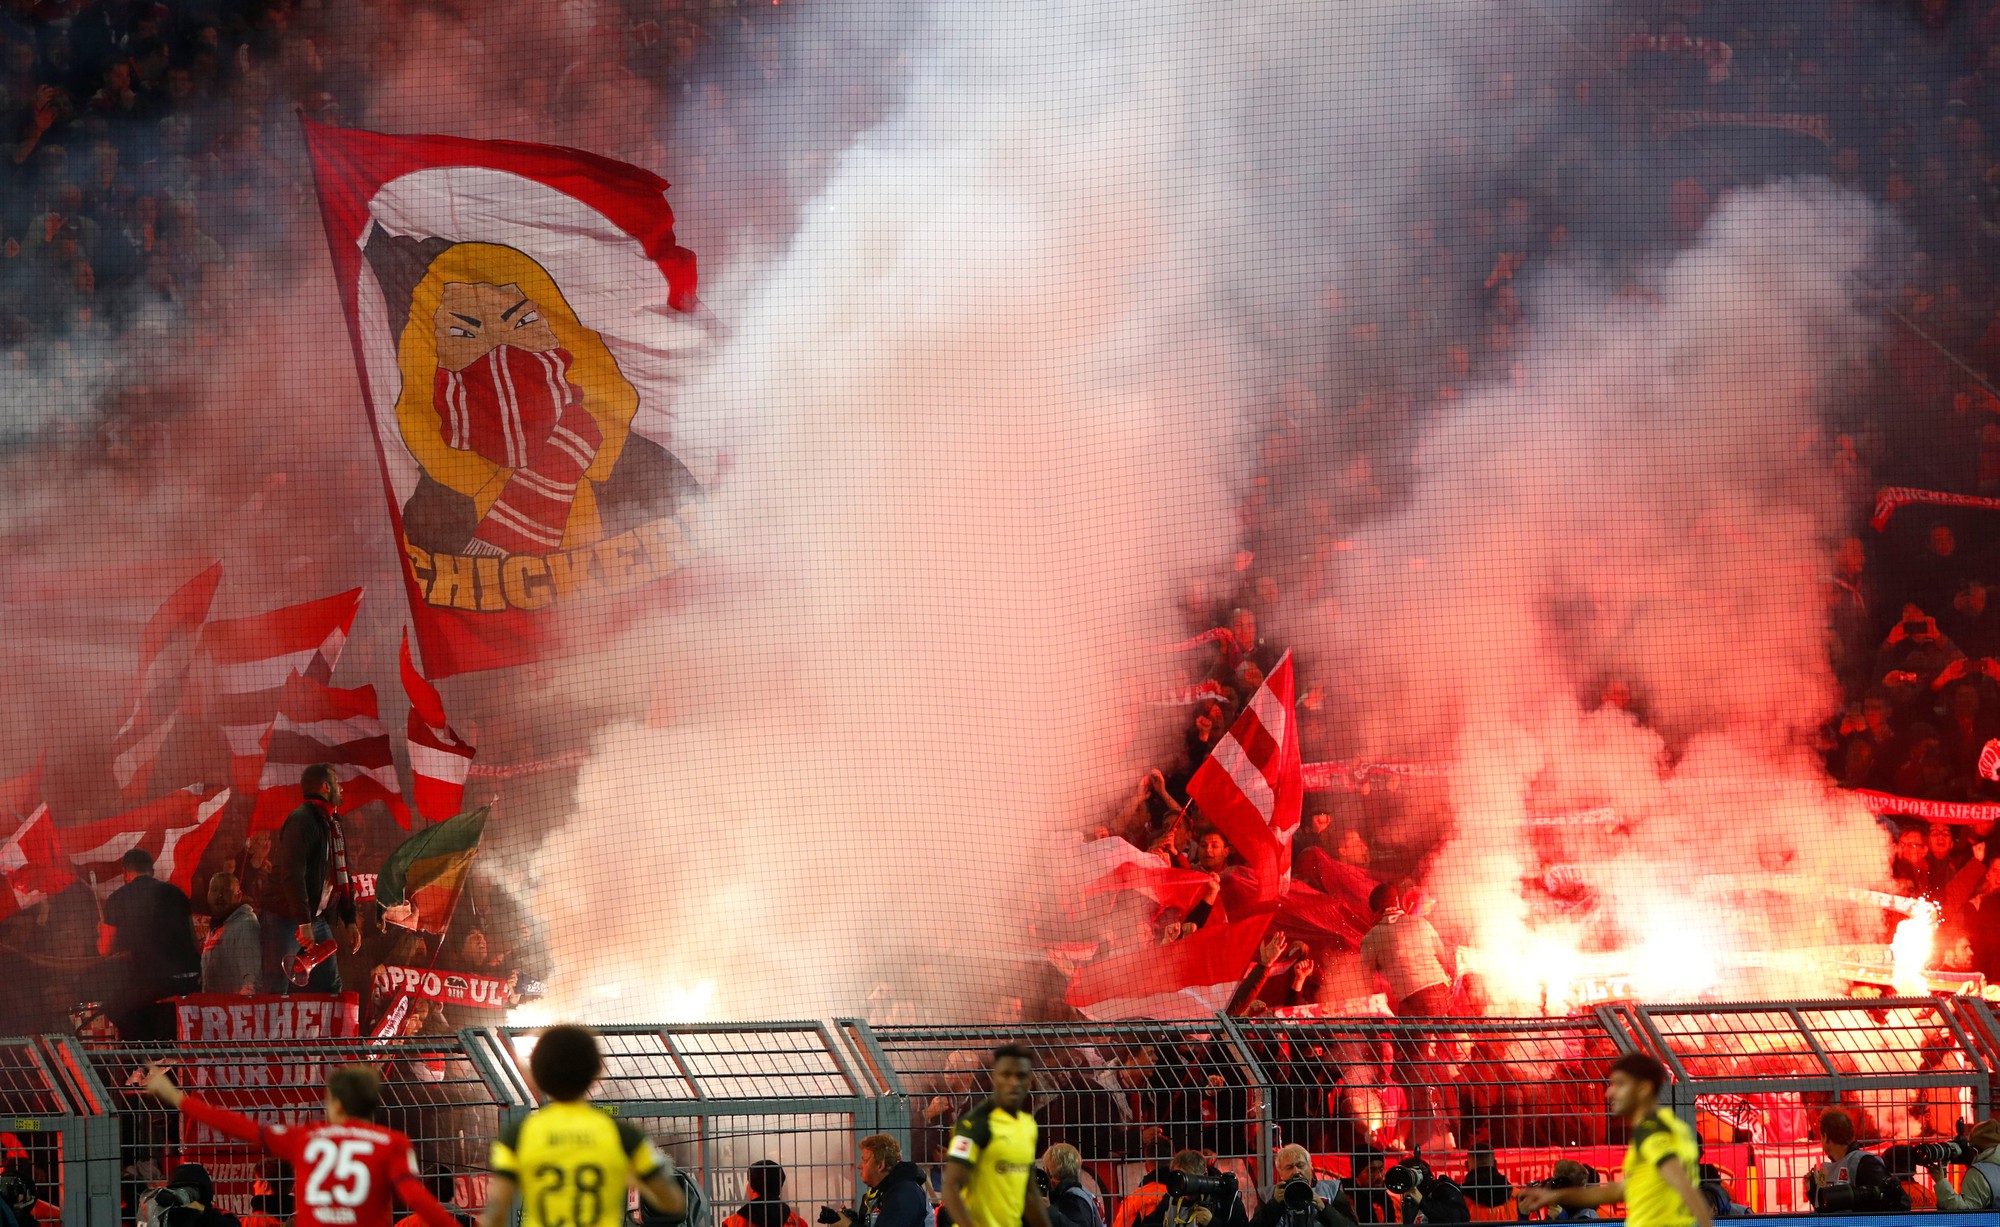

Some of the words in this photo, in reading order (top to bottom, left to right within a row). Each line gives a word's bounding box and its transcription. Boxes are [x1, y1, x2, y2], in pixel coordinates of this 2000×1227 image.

[179, 1002, 357, 1041] FREIHEIT
[304, 1138, 374, 1207] 25
[536, 1163, 604, 1227] 28
